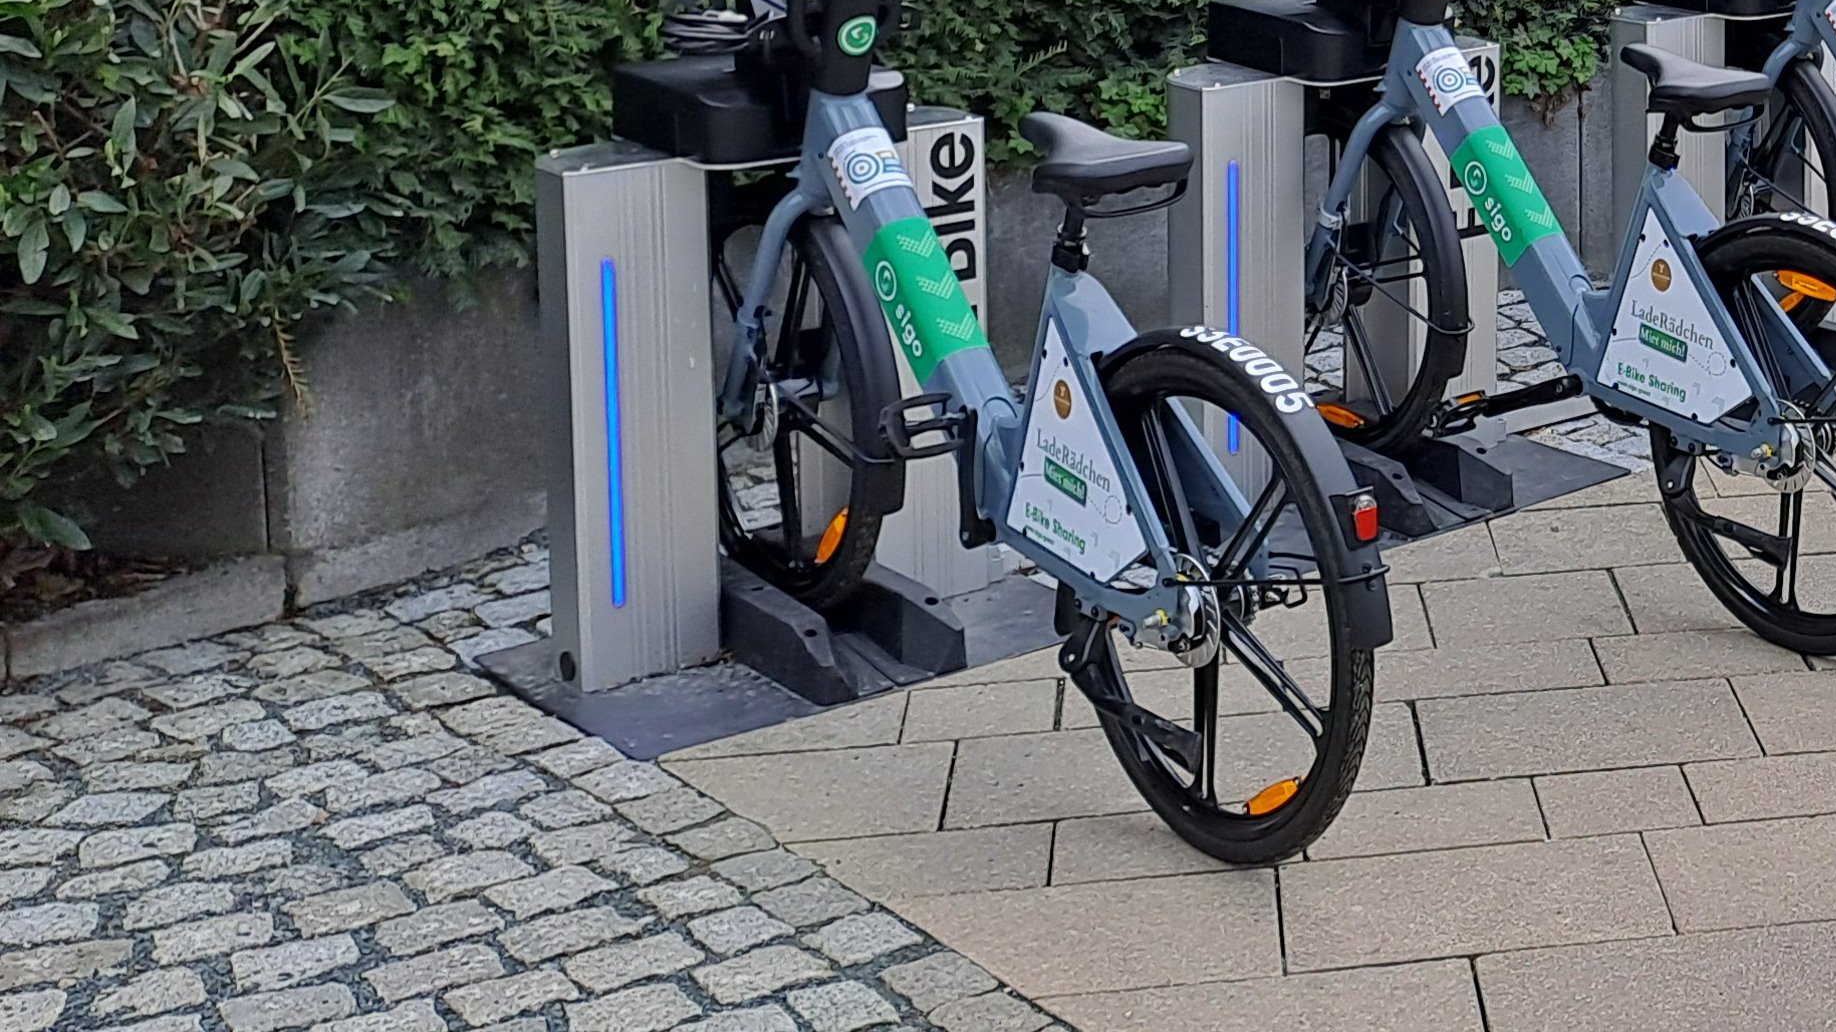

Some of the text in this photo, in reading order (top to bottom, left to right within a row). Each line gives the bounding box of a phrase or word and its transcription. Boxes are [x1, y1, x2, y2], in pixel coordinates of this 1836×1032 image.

[1484, 197, 1512, 242] sigo
[895, 304, 923, 357] sigo
[1630, 299, 1714, 350] LadeRädchen
[1640, 327, 1686, 358] Miet mich!
[1617, 362, 1686, 403] E-Bike Sharing
[1036, 428, 1111, 493] LadeRädchen
[1044, 459, 1064, 486] Miet
[1025, 501, 1050, 531] E-Bike
[1052, 517, 1087, 556] Sharing
